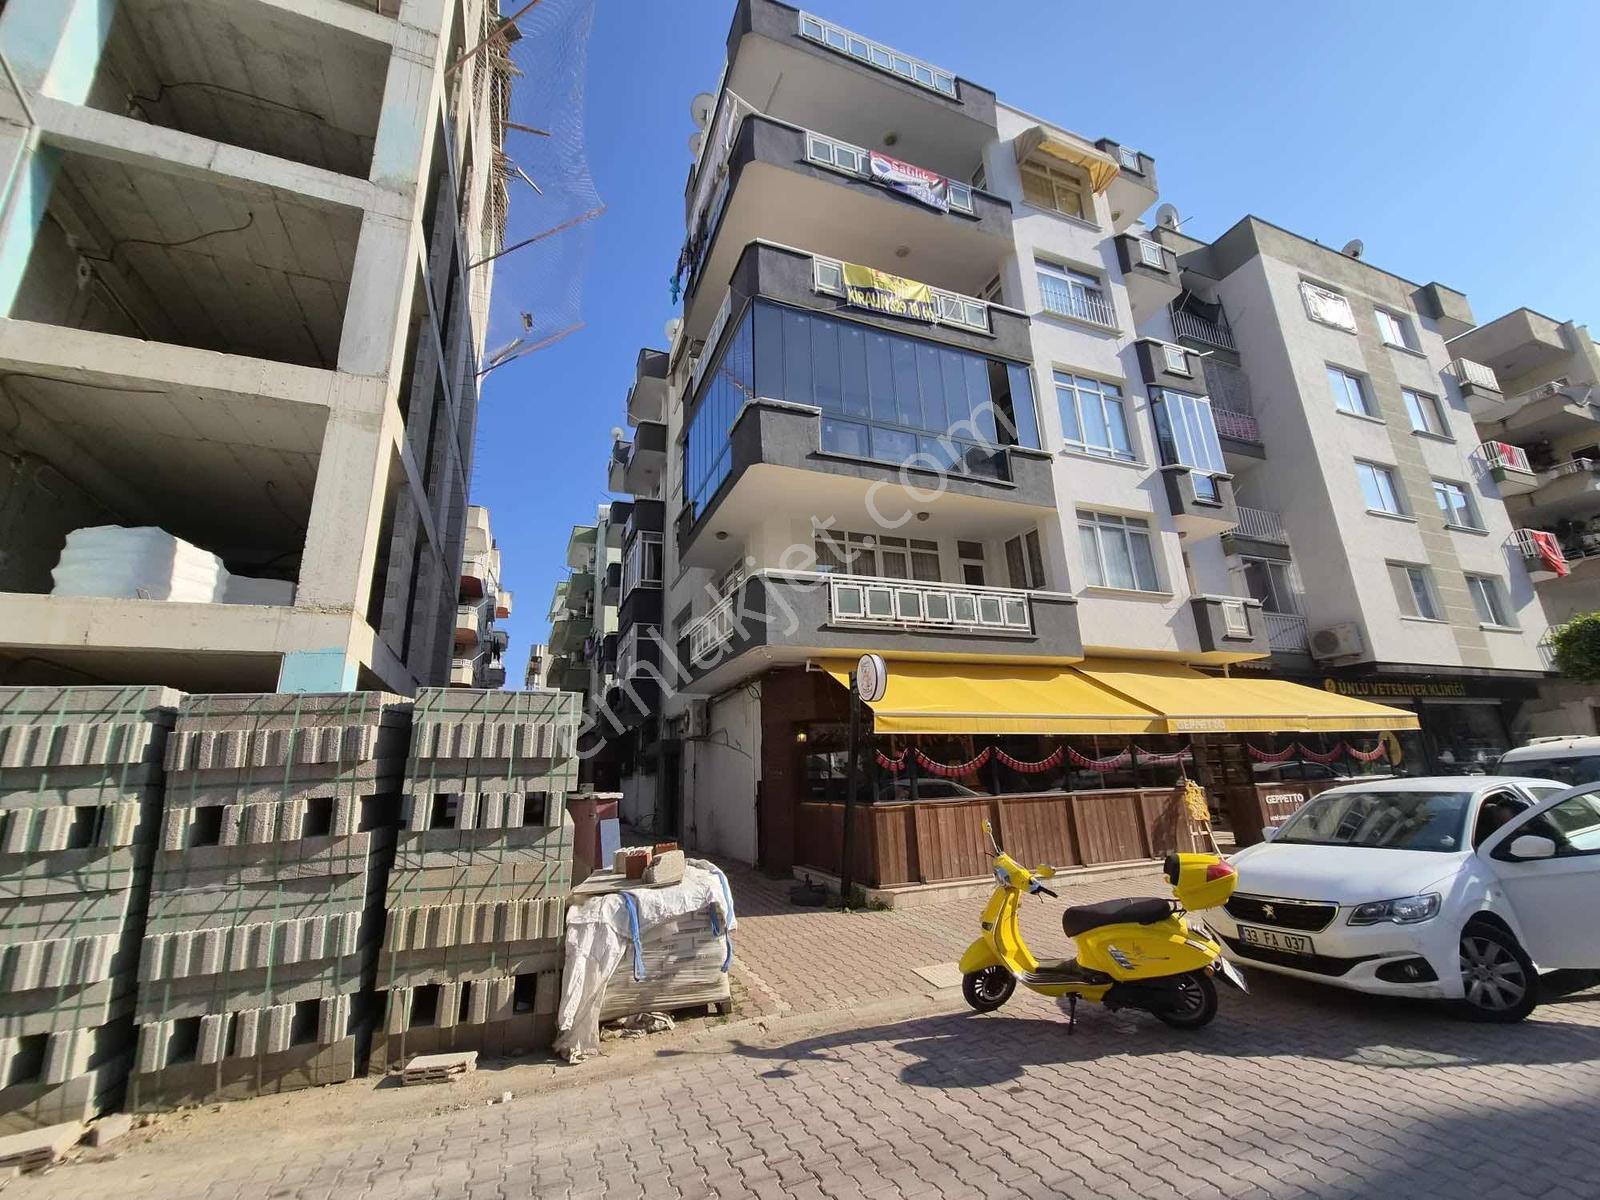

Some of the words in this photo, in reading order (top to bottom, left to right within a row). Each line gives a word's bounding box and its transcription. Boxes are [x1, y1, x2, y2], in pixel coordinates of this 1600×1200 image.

[1265, 793, 1304, 804] GEPPETTO
[1245, 928, 1258, 942] 33
[1264, 933, 1278, 946] FA
[1285, 936, 1304, 950] 037
